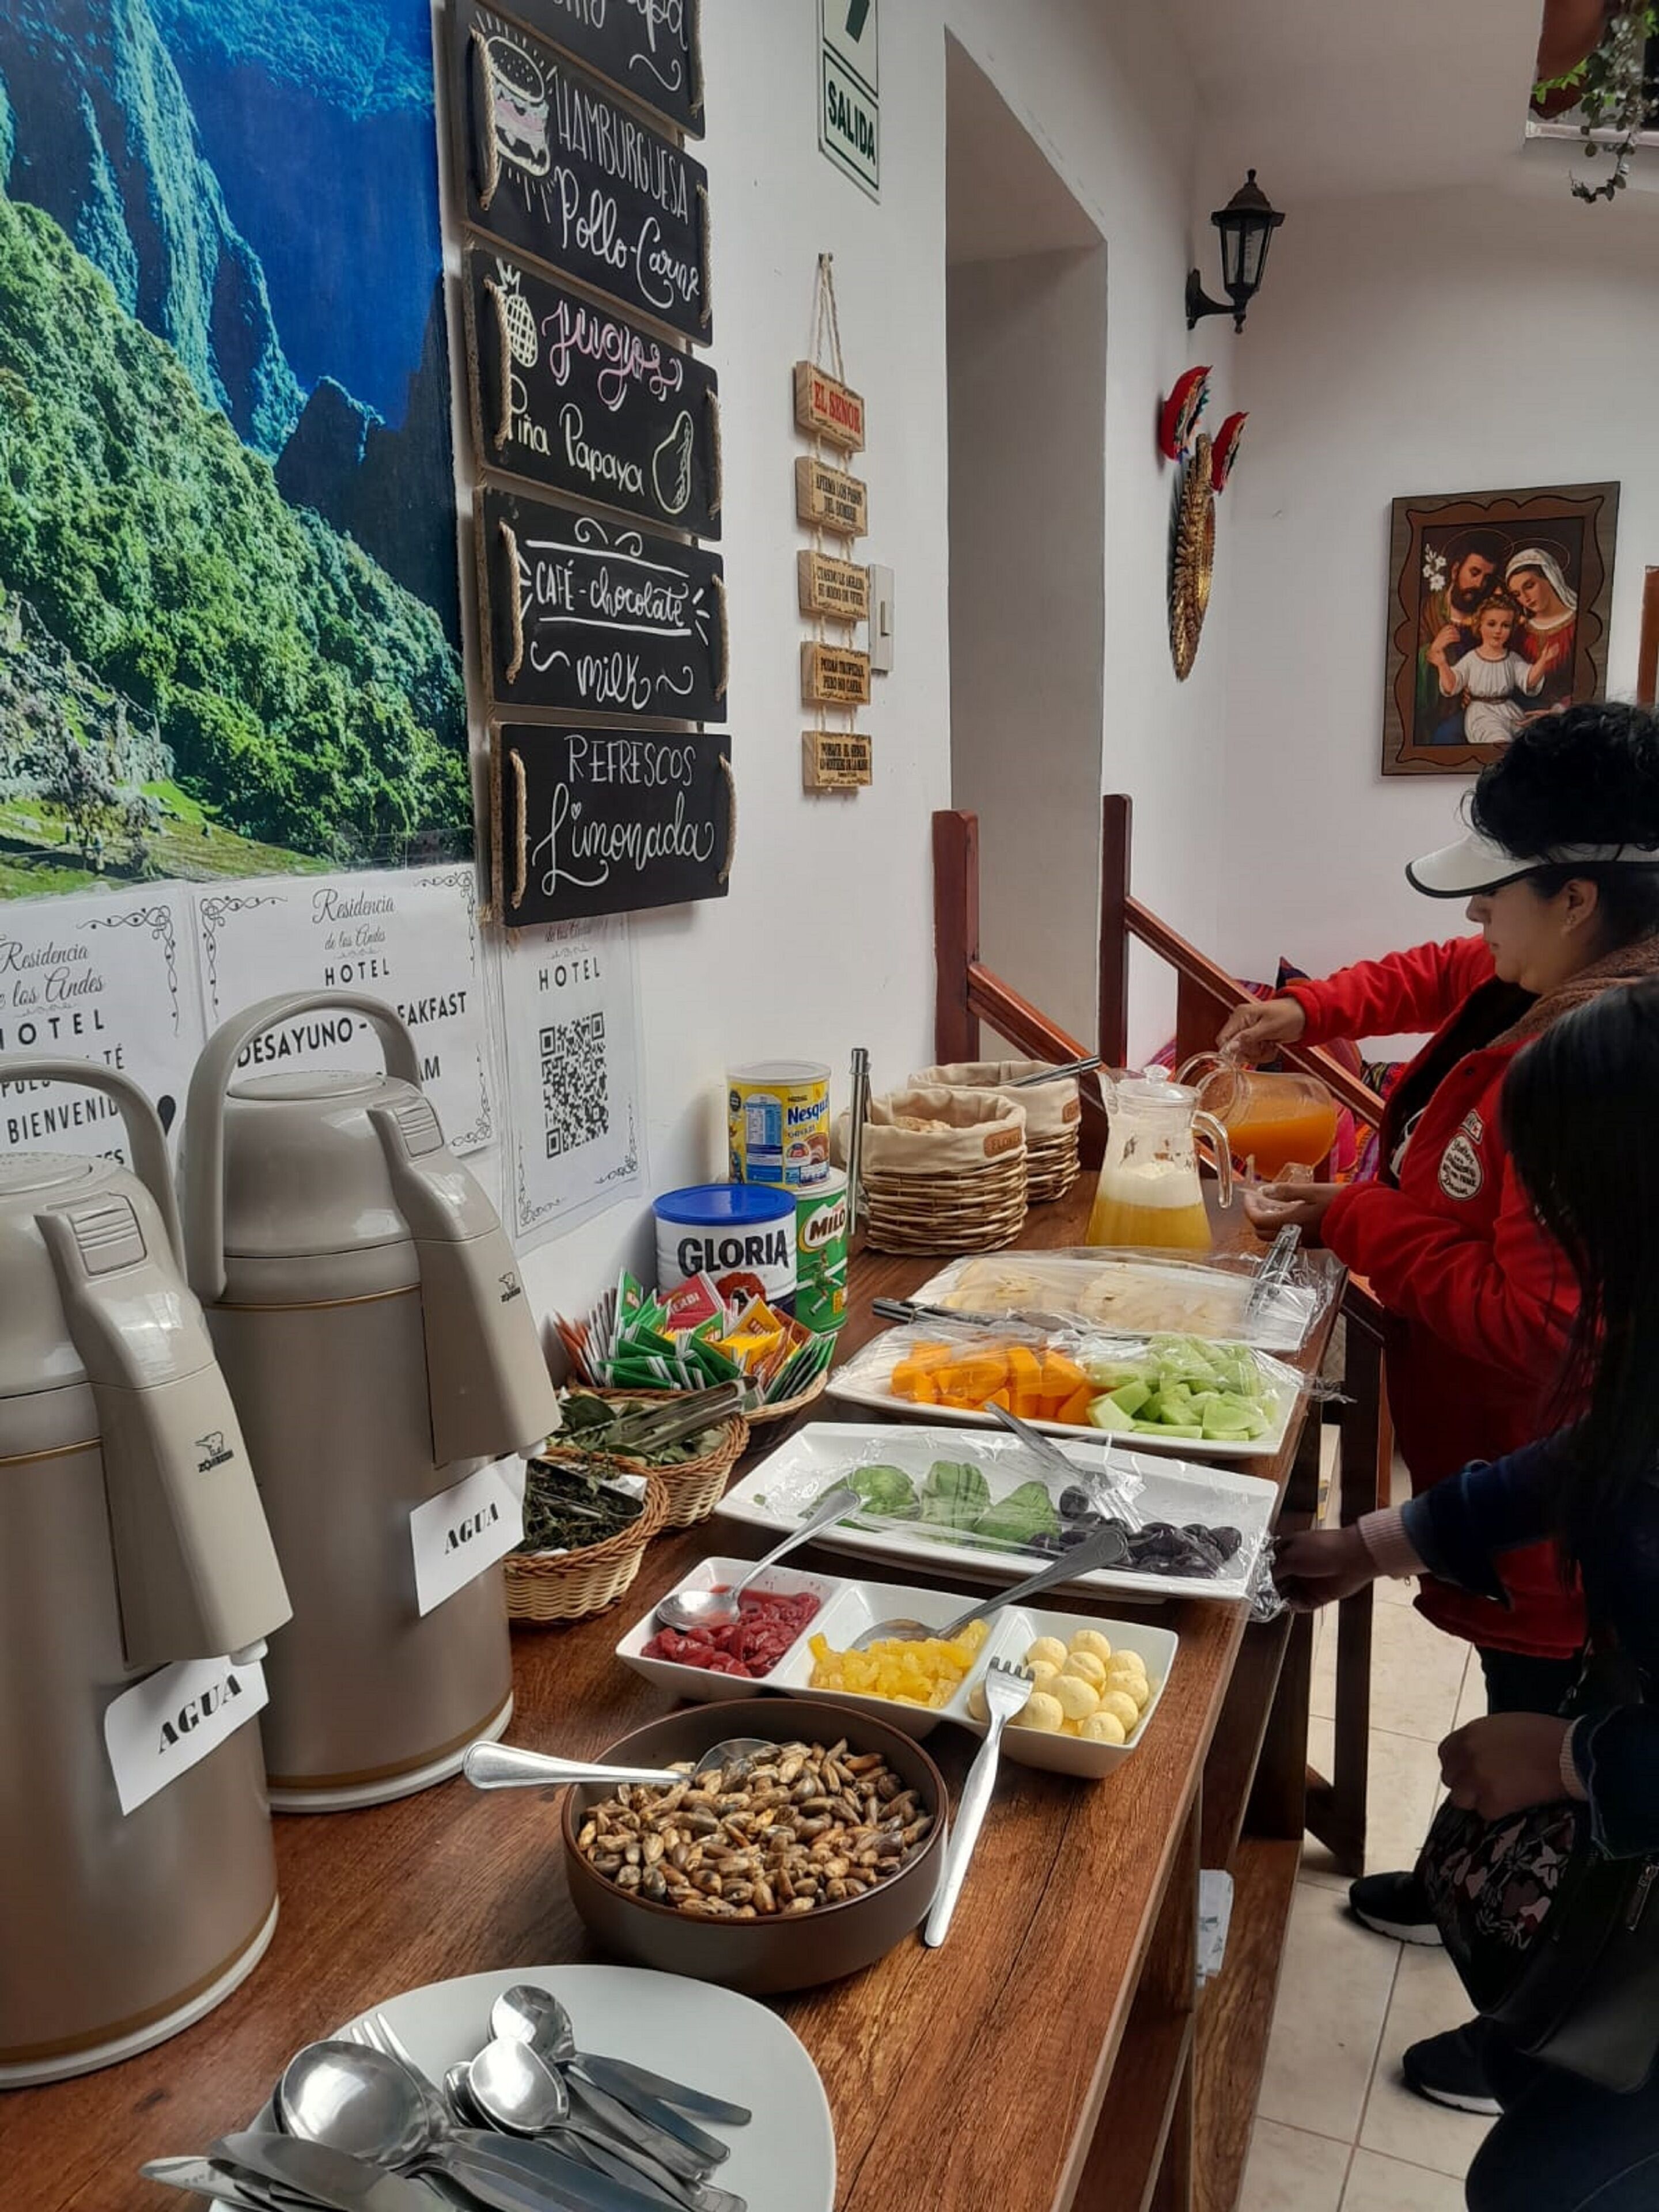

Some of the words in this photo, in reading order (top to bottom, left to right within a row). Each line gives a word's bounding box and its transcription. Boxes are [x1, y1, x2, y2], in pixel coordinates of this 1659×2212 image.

[547, 66, 688, 224] HAMBURGUESA
[828, 80, 876, 166] SALIDA
[542, 300, 683, 411] Jugos
[815, 380, 827, 415] EL
[559, 403, 645, 497] Papaya
[537, 560, 574, 611] CAFÉ
[590, 566, 689, 627] chocolate
[564, 734, 696, 787] REFRESCOS
[532, 783, 714, 896] Limonada
[312, 889, 395, 924] Residencia
[0, 941, 88, 974] Residencia
[325, 933, 335, 950] de
[355, 923, 386, 946] Andes
[44, 967, 103, 1003] Andes
[325, 957, 390, 986] HOTEL
[539, 956, 600, 991] HOTEL
[7, 1096, 119, 1144] BIENVENID
[809, 1209, 845, 1241] MILO
[677, 1229, 789, 1278] GLORIA
[445, 1503, 499, 1555] AGUA
[158, 1673, 243, 1755] AGUA
